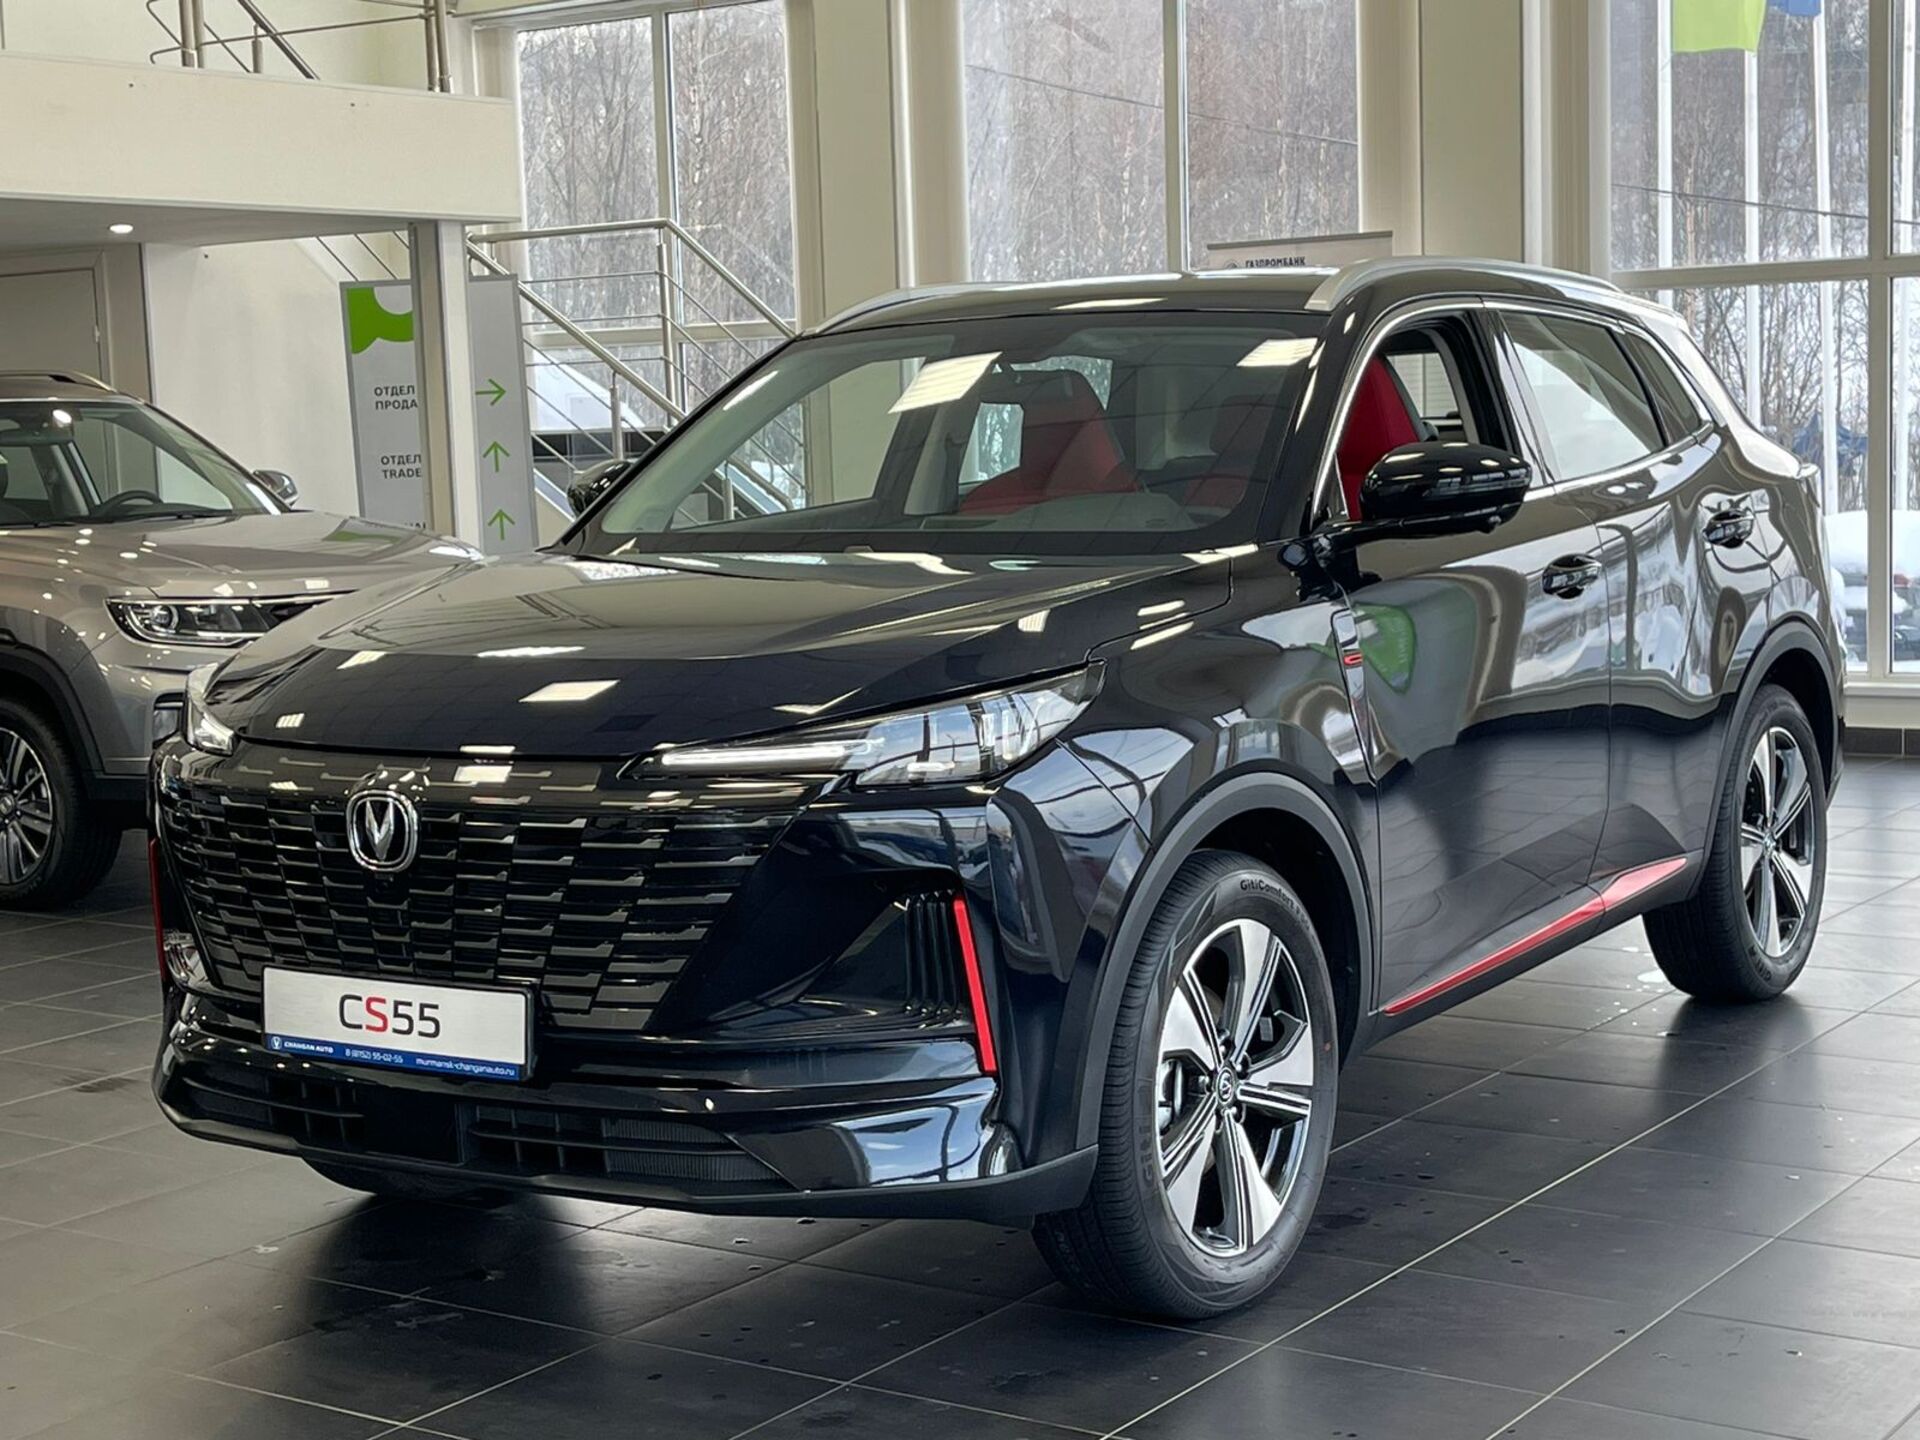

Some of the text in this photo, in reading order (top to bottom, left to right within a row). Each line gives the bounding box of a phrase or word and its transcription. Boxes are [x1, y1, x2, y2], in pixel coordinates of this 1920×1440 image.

[1245, 256, 1306, 267] ГАЗПРОМБАНК
[374, 385, 415, 397] ОТДЕЛ
[380, 454, 422, 466] ОТДЕЛ
[382, 467, 422, 479] TRADE
[1240, 879, 1294, 910] GitiComfort
[339, 994, 441, 1039] CS55
[315, 1045, 334, 1055] AUTO
[372, 1052, 403, 1064] 55-02-55
[415, 1057, 516, 1076] murmansk-changanauto.ru
